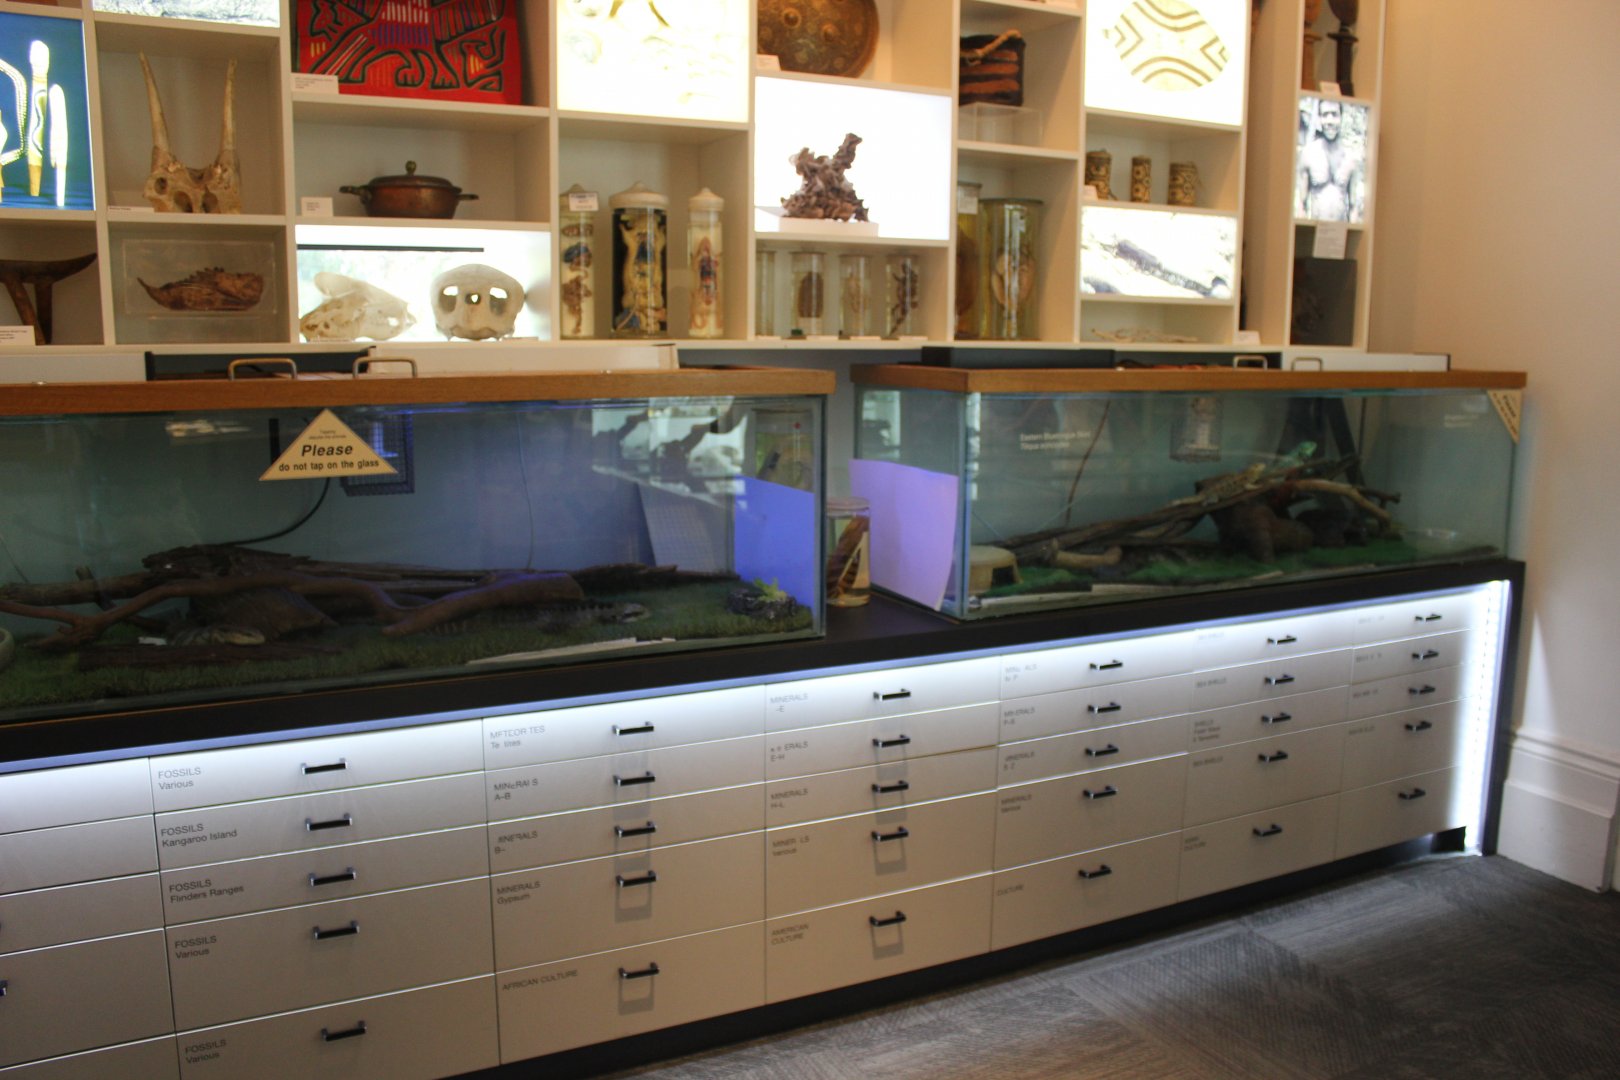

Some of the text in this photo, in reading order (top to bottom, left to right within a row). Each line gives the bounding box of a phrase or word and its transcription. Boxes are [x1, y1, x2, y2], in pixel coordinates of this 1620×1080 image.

[301, 444, 354, 457] Please
[279, 458, 380, 472] do not tap on the glass
[490, 725, 546, 740] METEORTES
[490, 740, 522, 750] Tetites
[158, 767, 202, 780] FOSSILS
[158, 780, 194, 791] Various
[494, 792, 511, 801] A-B
[160, 823, 205, 837] FOSSILS
[162, 829, 239, 848] Kangaroo Island
[772, 835, 810, 848] MINERLS
[169, 879, 213, 893] FOSSILS
[497, 881, 542, 895] MINERALS
[170, 885, 245, 904] Flinders Ranges
[174, 935, 218, 949] FOSSILS
[175, 947, 211, 960] Various
[502, 969, 579, 991] AFRICAN CULTURE
[185, 1039, 228, 1054] FOSSILS
[186, 1051, 221, 1064] Various
